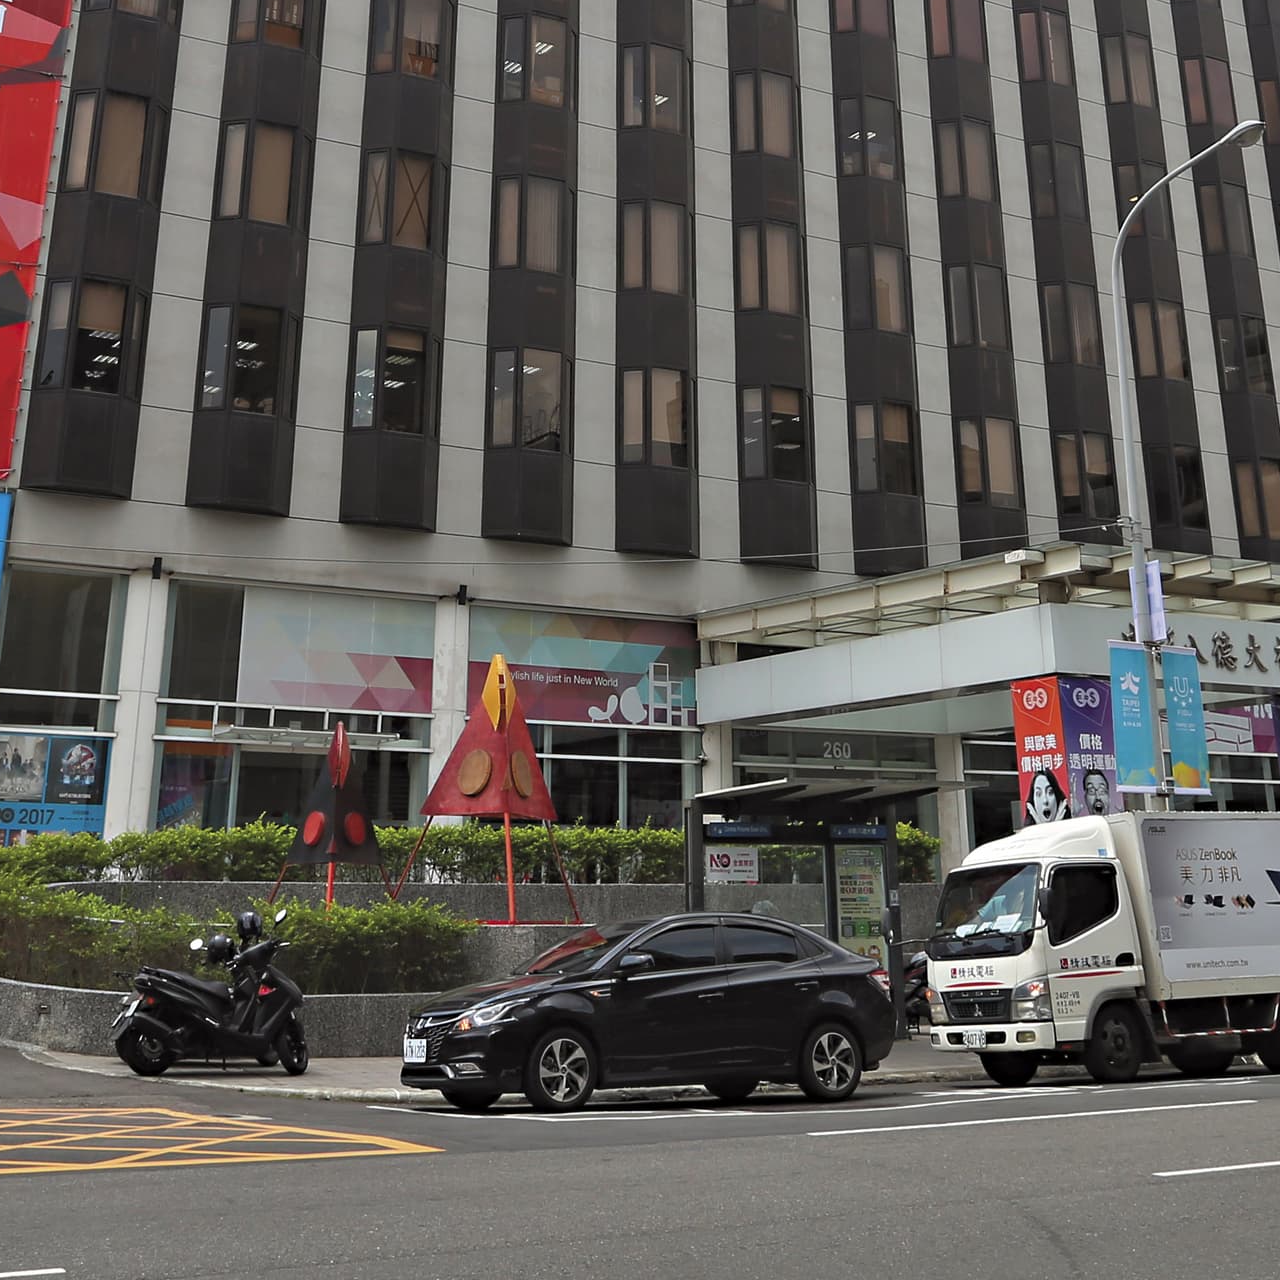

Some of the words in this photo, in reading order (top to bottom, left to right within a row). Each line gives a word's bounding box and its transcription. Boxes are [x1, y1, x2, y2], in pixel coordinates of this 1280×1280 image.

[510, 670, 530, 681] ylish
[531, 671, 544, 682] life
[545, 673, 562, 685] just
[563, 674, 572, 684] in
[573, 675, 593, 685] New
[594, 676, 619, 688] World
[1024, 733, 1057, 752] 與歐美
[1079, 733, 1103, 750] 價格
[823, 742, 852, 759] 260
[1021, 753, 1064, 773] 價格同步
[1068, 753, 1117, 770] 透明運動
[17, 808, 55, 825] 2017
[1175, 848, 1198, 861] ASUS
[1199, 848, 1238, 861] ZenBook
[1070, 955, 1112, 968] 精技電腦
[1185, 959, 1249, 969] www.unitech.com.tw
[958, 965, 995, 979] 精技電腦
